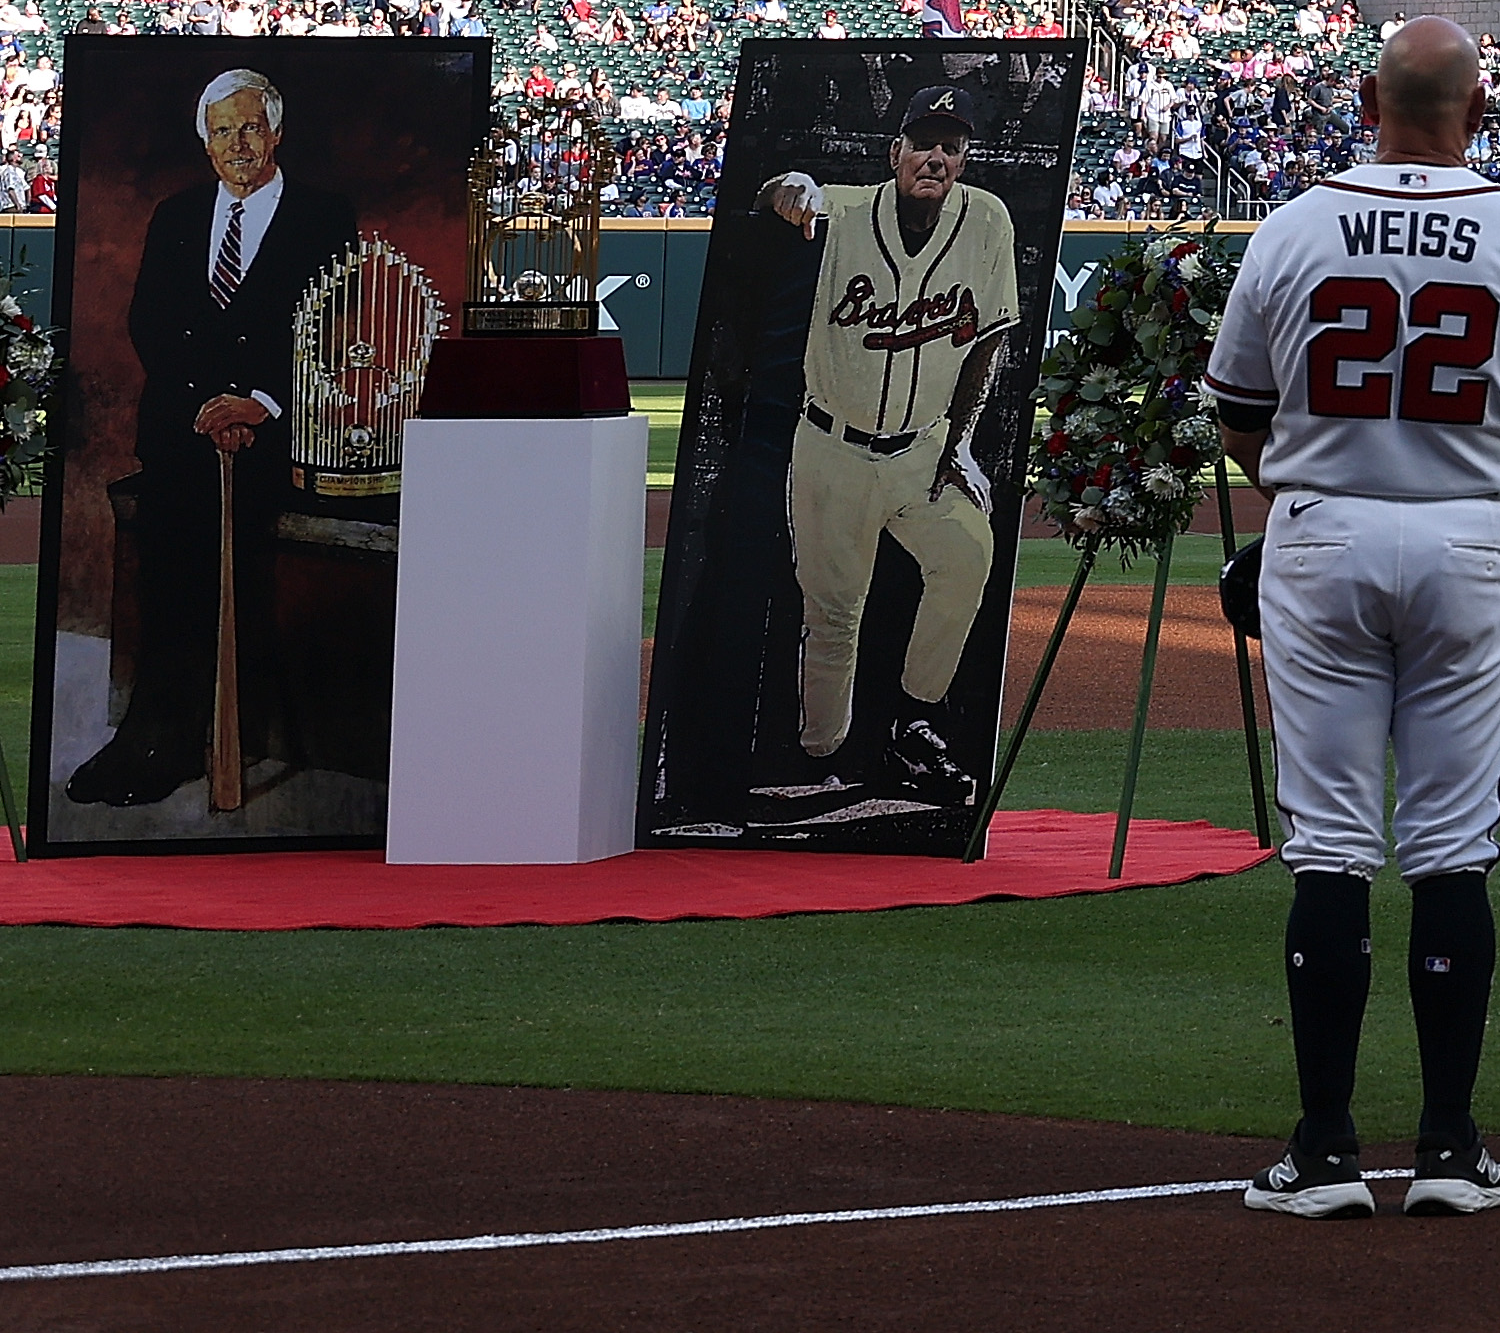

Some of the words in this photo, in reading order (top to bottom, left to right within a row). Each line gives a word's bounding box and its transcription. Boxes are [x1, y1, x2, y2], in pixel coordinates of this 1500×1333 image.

[1338, 210, 1482, 263] WEISS
[828, 274, 962, 329] Braves
[1307, 275, 1500, 426] 22
